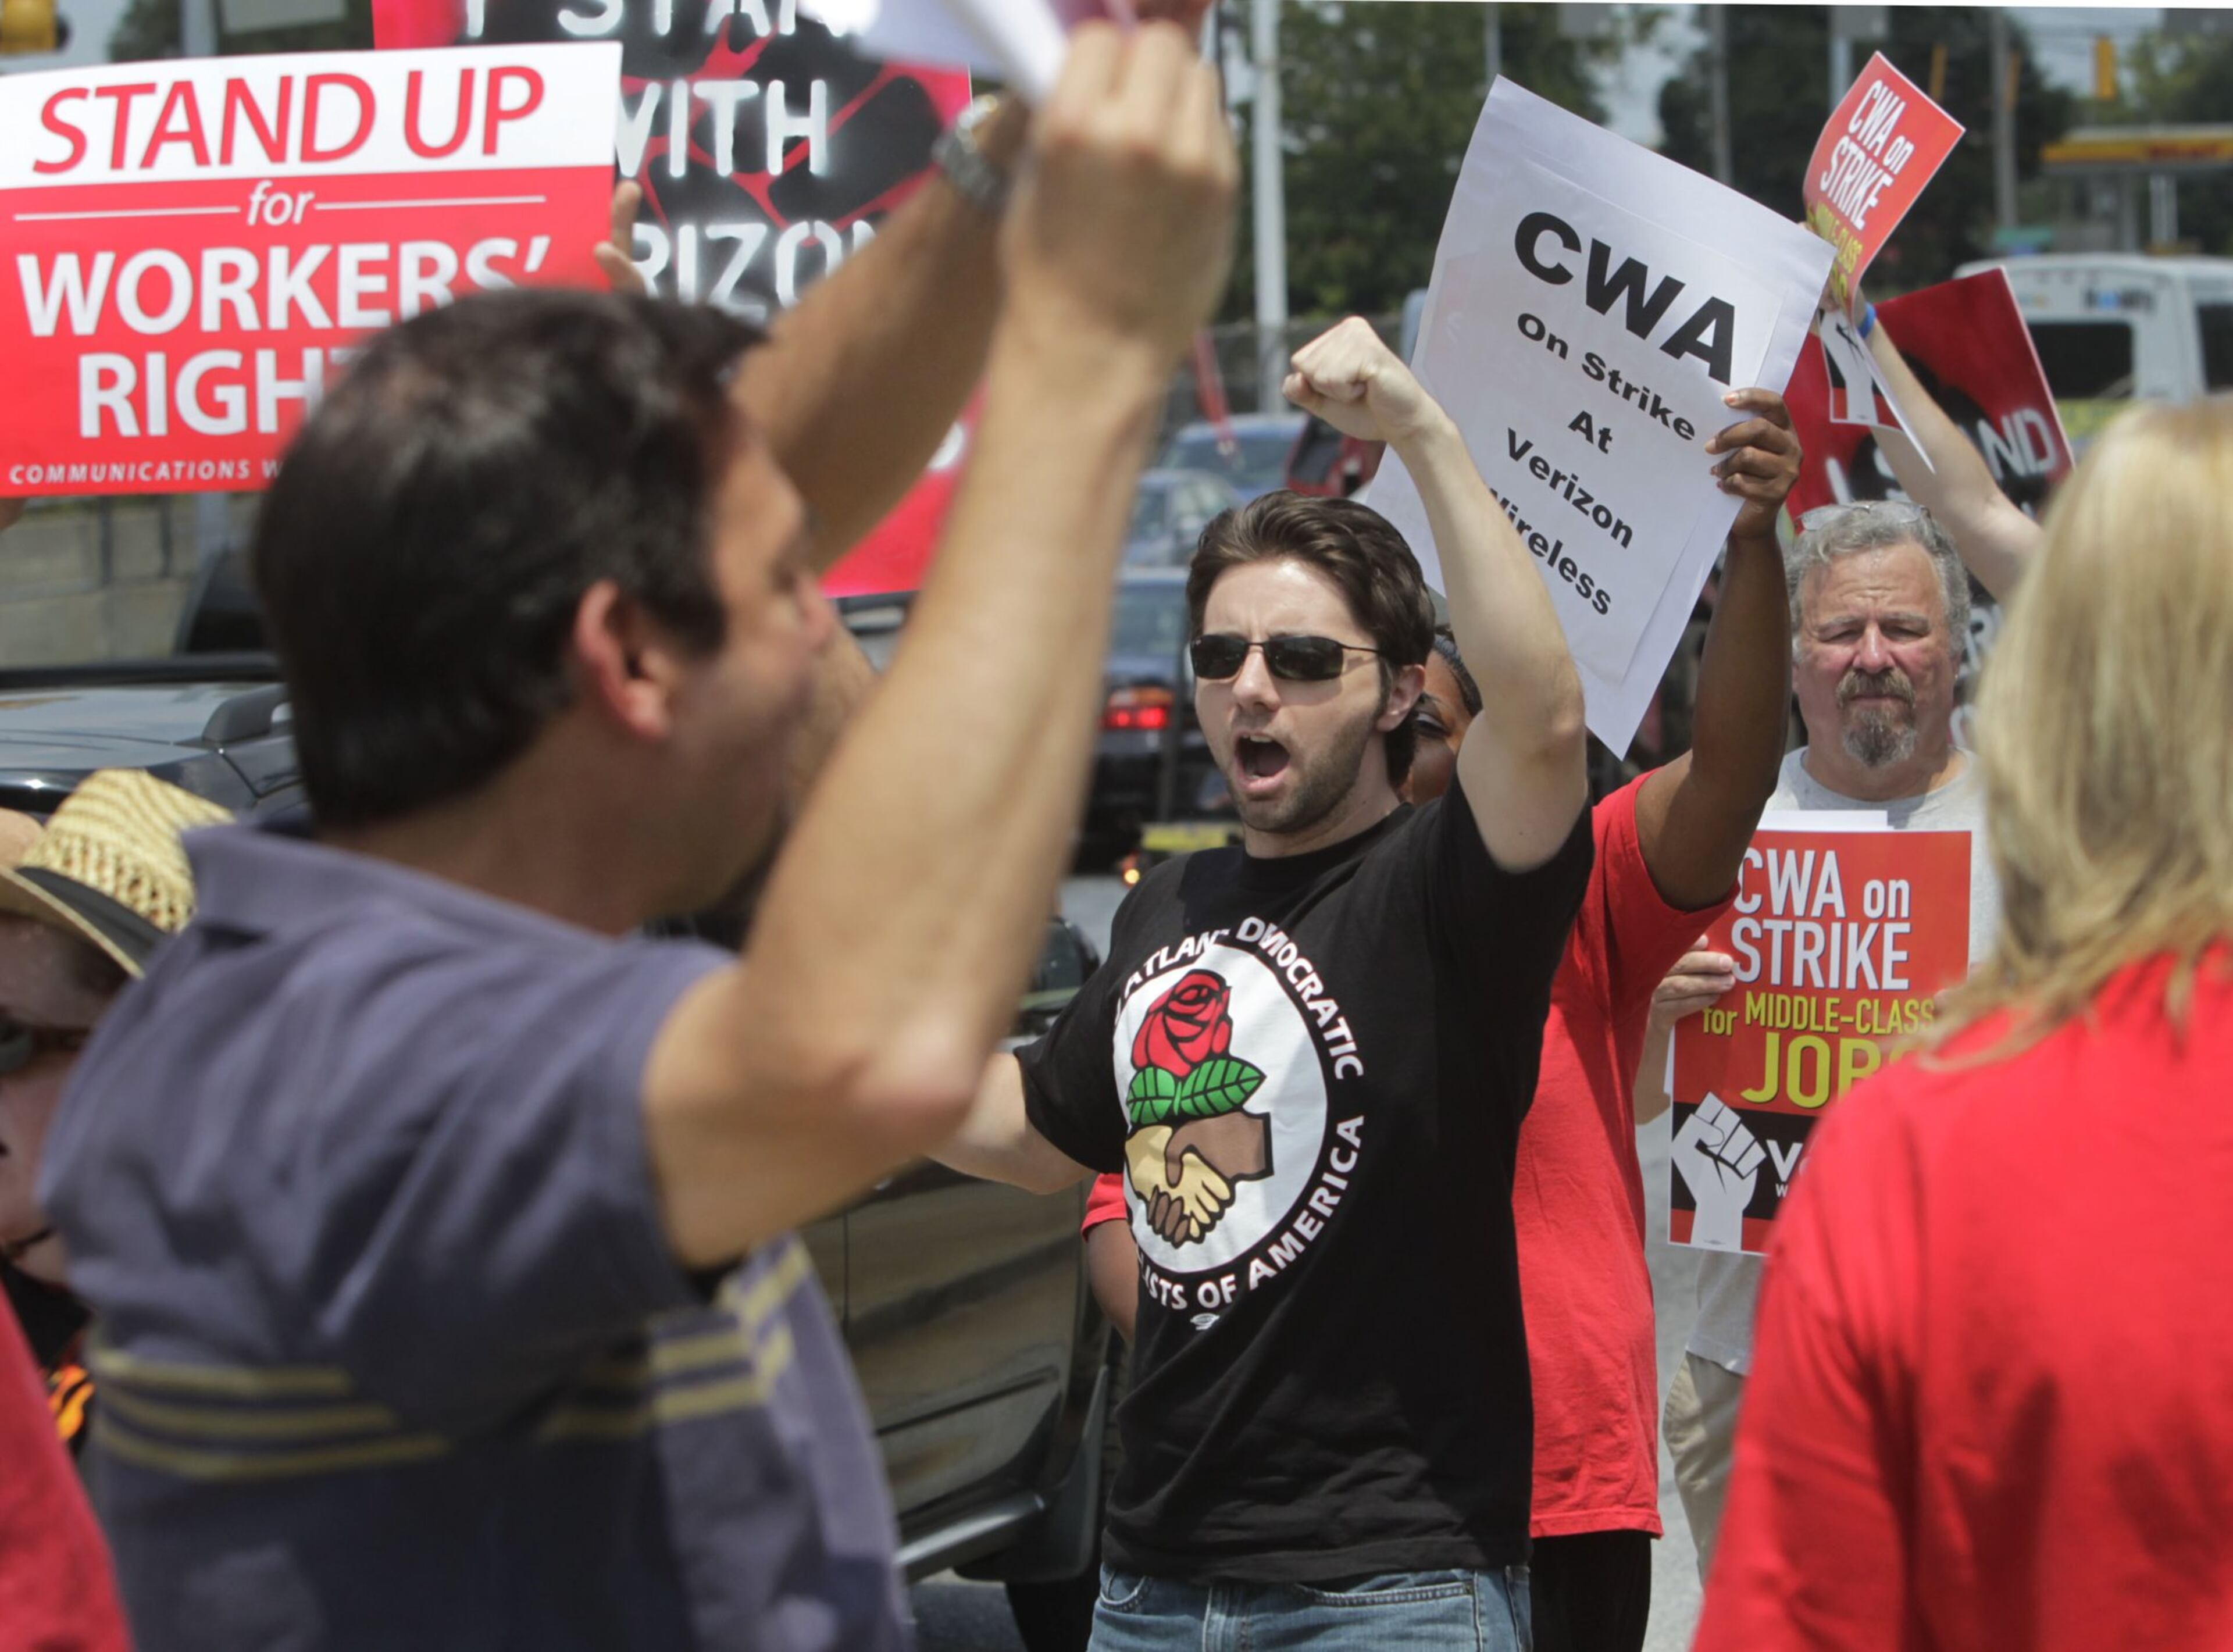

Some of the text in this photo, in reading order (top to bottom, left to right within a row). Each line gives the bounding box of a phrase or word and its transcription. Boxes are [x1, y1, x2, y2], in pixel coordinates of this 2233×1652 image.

[33, 65, 545, 174] STAND UP
[1848, 79, 1914, 175] CWA on
[247, 181, 315, 226] for
[1820, 135, 1895, 231] STRIKE
[16, 235, 551, 337] WORKERS'
[1514, 211, 1736, 386] CWA
[79, 347, 370, 438] RIGH
[1517, 312, 1568, 359] On
[1581, 351, 1696, 441] Strike
[8, 458, 251, 486] COMMUNICATIONS
[1568, 410, 1613, 455] At
[1507, 427, 1633, 550] Verizon
[1733, 847, 1910, 919] CWA on
[1732, 918, 1911, 991] STRIKE
[1702, 990, 1935, 1036] for MIDDLE-CLASS
[1740, 1032, 1913, 1109] JOB
[1197, 1273, 1237, 1308] OF
[1249, 1115, 1364, 1291] AMERICA
